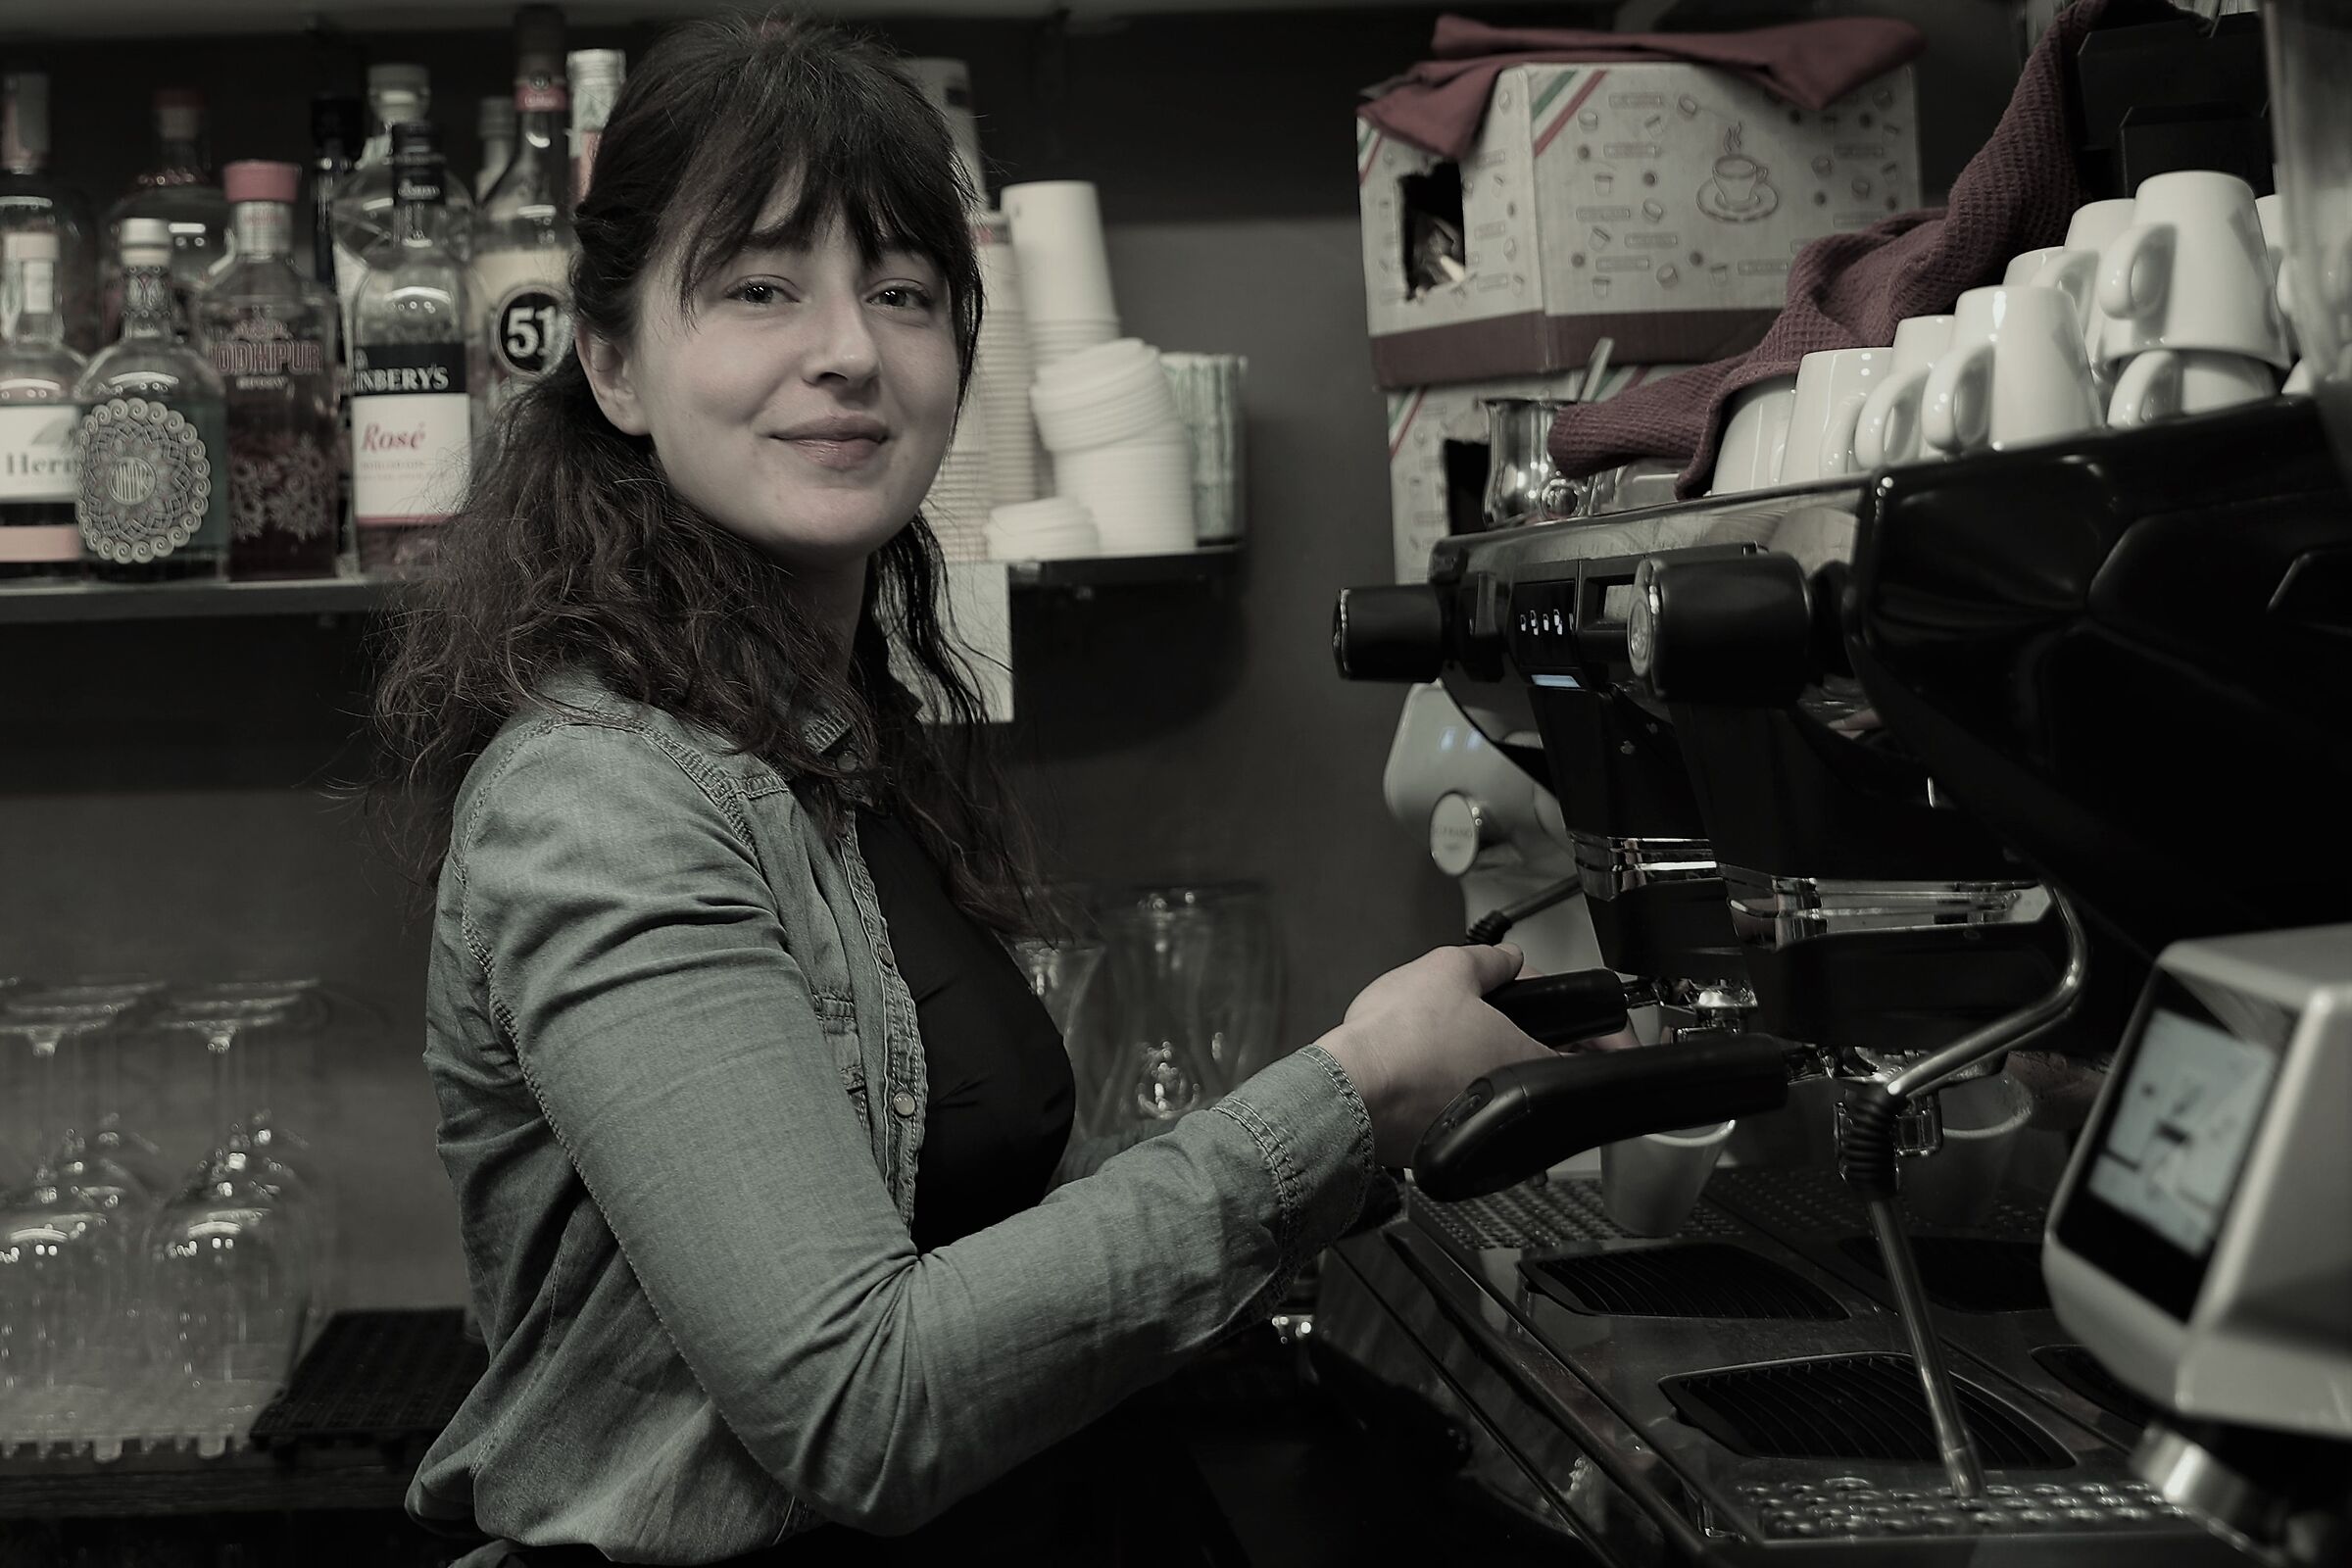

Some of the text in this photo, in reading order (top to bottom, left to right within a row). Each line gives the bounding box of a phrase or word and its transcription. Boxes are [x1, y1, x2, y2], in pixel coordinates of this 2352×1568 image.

[507, 305, 558, 359] 51
[210, 340, 324, 374] ODHPUR
[361, 421, 427, 453] Rosé
